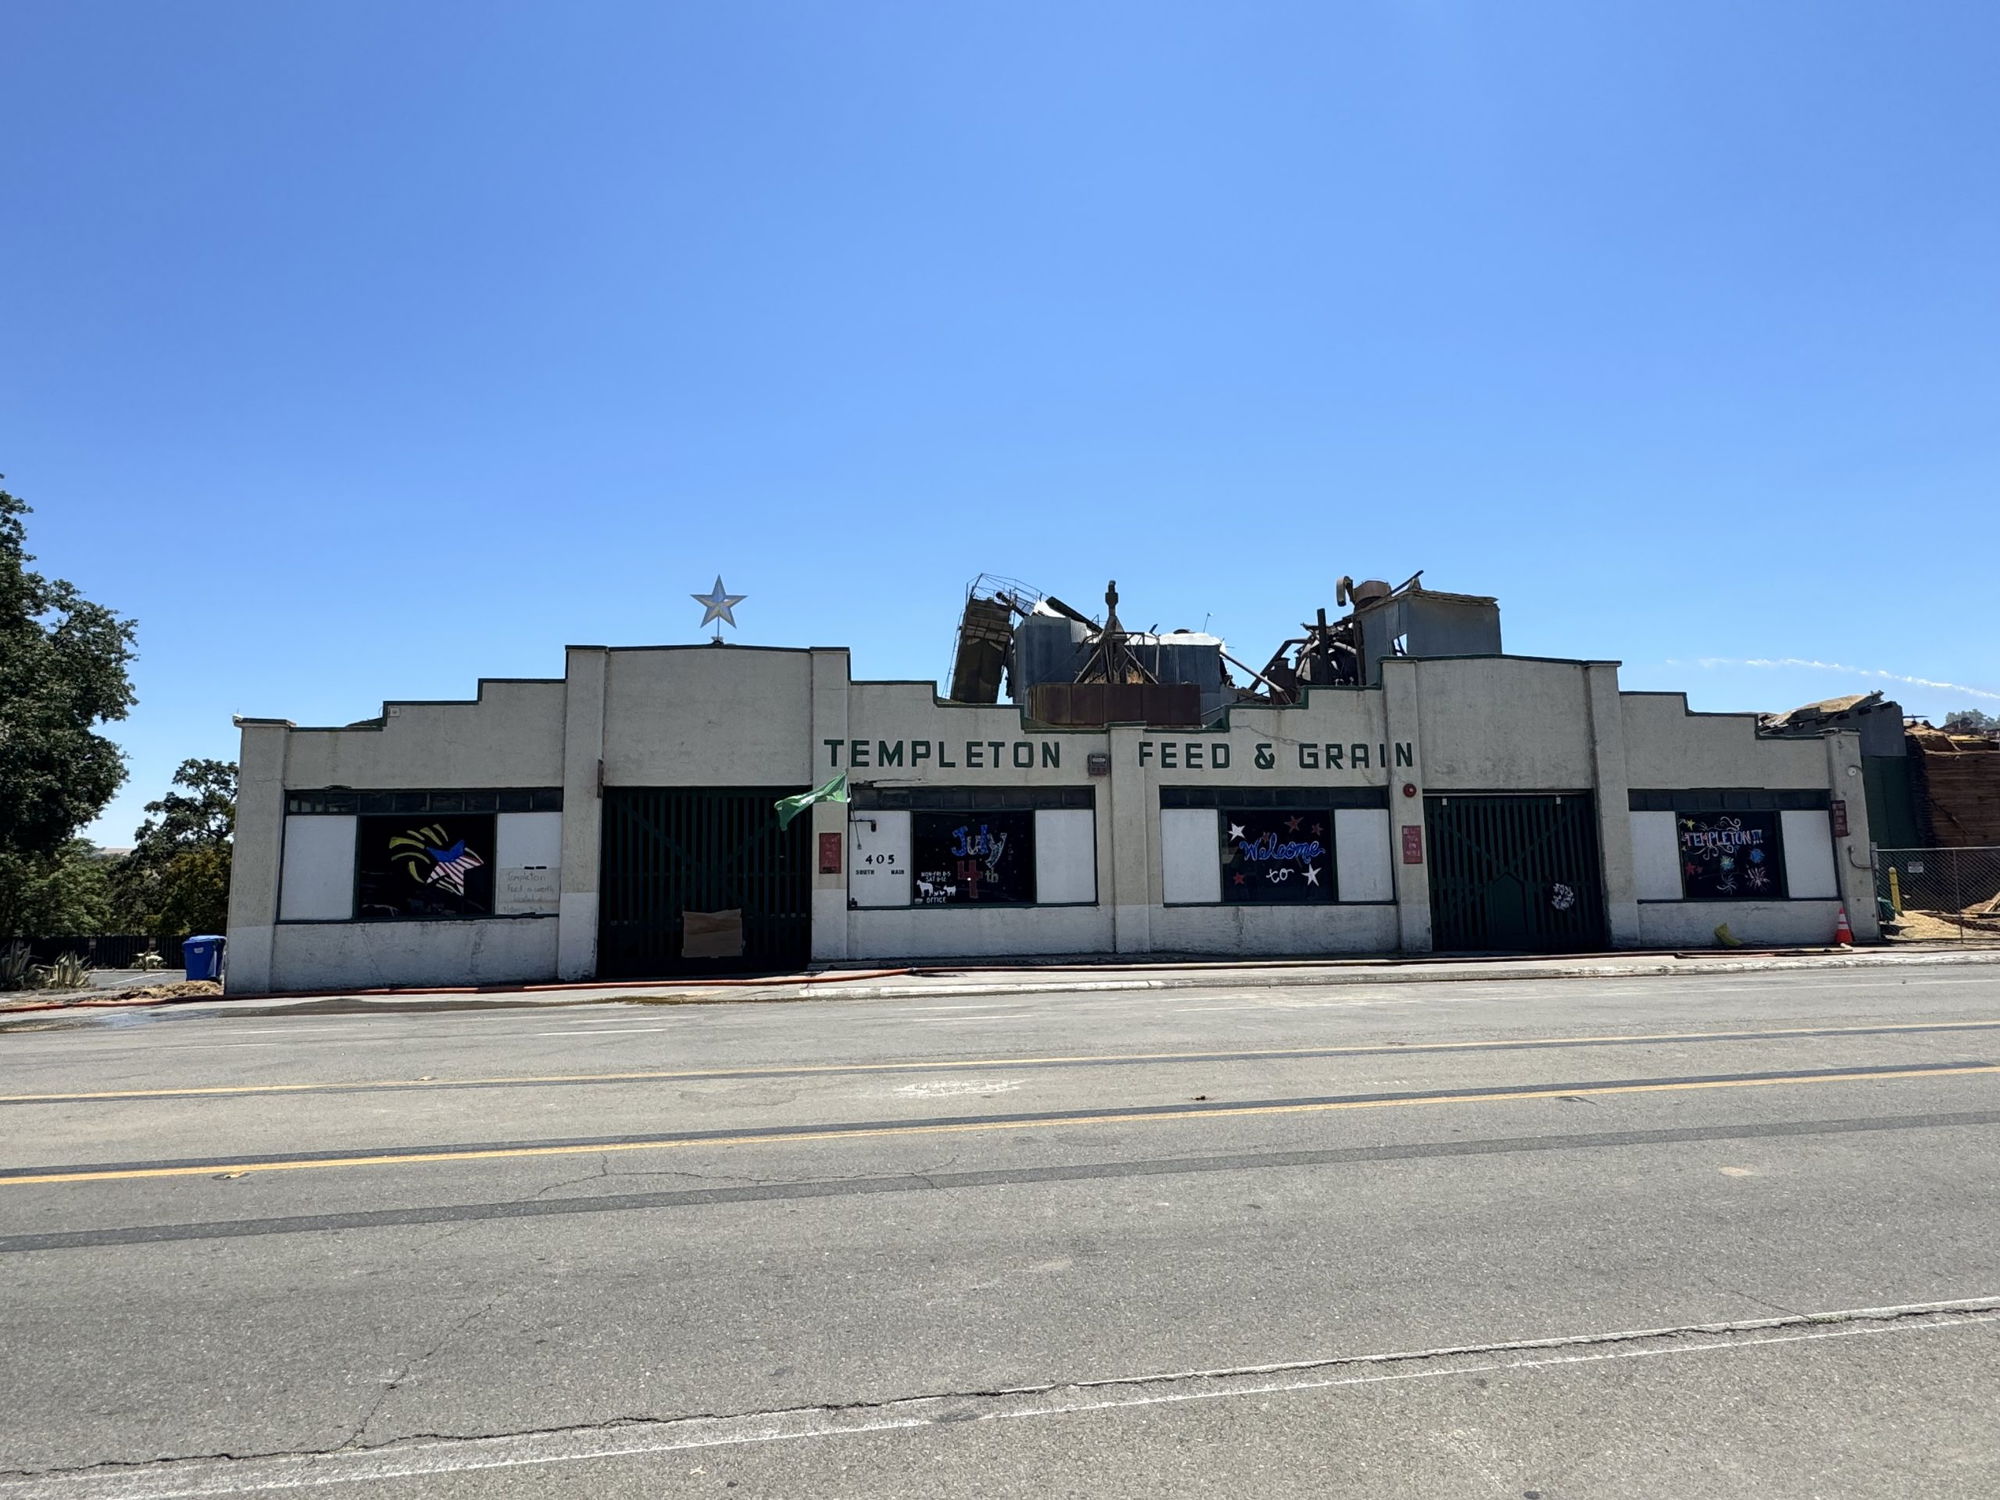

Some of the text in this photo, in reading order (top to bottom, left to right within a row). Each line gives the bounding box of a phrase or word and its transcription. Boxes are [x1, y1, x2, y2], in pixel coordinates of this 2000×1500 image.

[823, 739, 1414, 770] TEMPLETON FEED & GRAIN
[865, 854, 895, 865] 405
[951, 824, 1008, 868] July
[1239, 832, 1326, 865] Welcome
[1266, 868, 1294, 884] to
